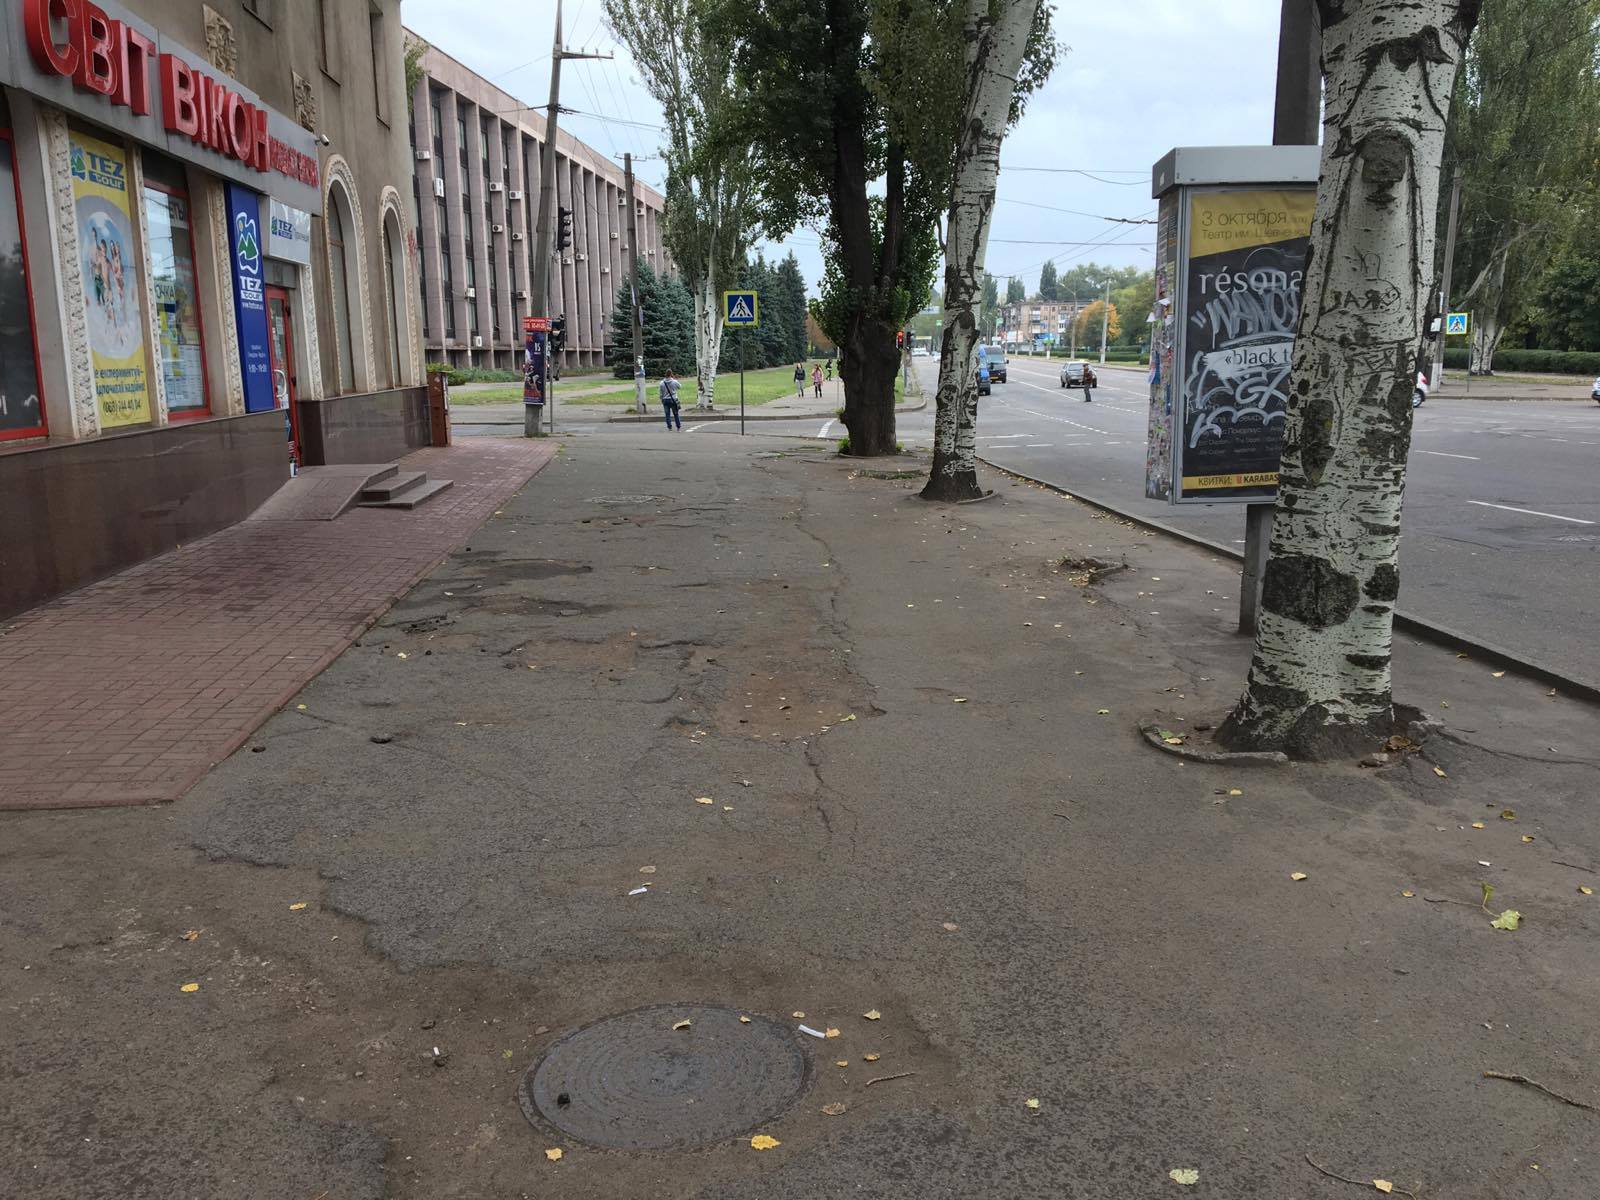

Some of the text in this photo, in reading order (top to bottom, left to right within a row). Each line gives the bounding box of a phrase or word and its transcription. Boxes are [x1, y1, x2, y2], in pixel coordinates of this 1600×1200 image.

[23, 0, 157, 115] СВІТ
[160, 53, 270, 172] ВІКОН
[87, 152, 124, 179] TEZ
[278, 219, 293, 232] TEZ
[1201, 210, 1214, 226] 3
[1217, 208, 1288, 228] октября
[1202, 229, 1232, 241] Театр
[240, 275, 262, 291] TEZ
